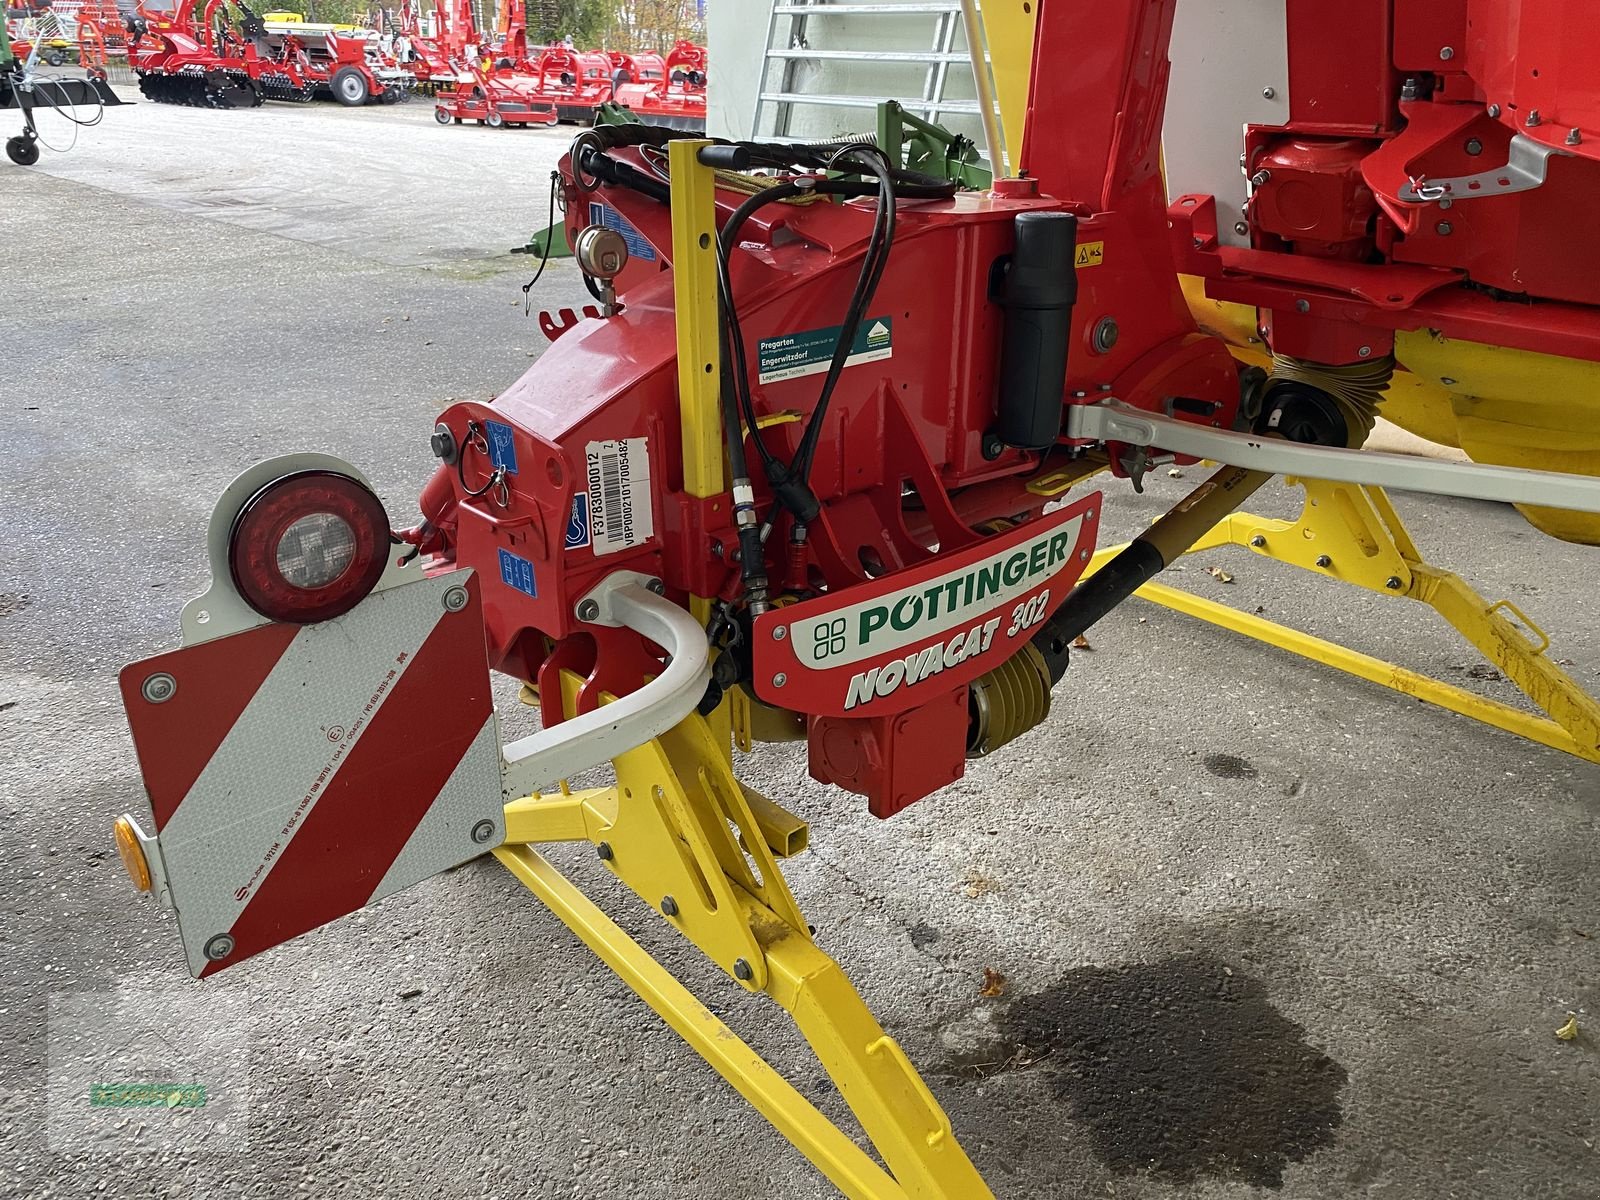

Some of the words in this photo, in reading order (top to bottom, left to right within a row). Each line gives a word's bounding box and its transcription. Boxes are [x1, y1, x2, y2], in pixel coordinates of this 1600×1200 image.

[761, 339, 794, 350] Pregarten
[762, 350, 808, 366] Engerwitzdorf
[763, 372, 788, 381] Lagerhaus
[588, 452, 605, 536] F3783000012
[618, 440, 634, 546] VBP00021017005482
[859, 531, 1068, 645] PÖTTINGER
[844, 616, 1002, 711] NOVACAT
[1007, 589, 1050, 639] 302
[332, 750, 342, 761] 104
[347, 717, 365, 739] 004251
